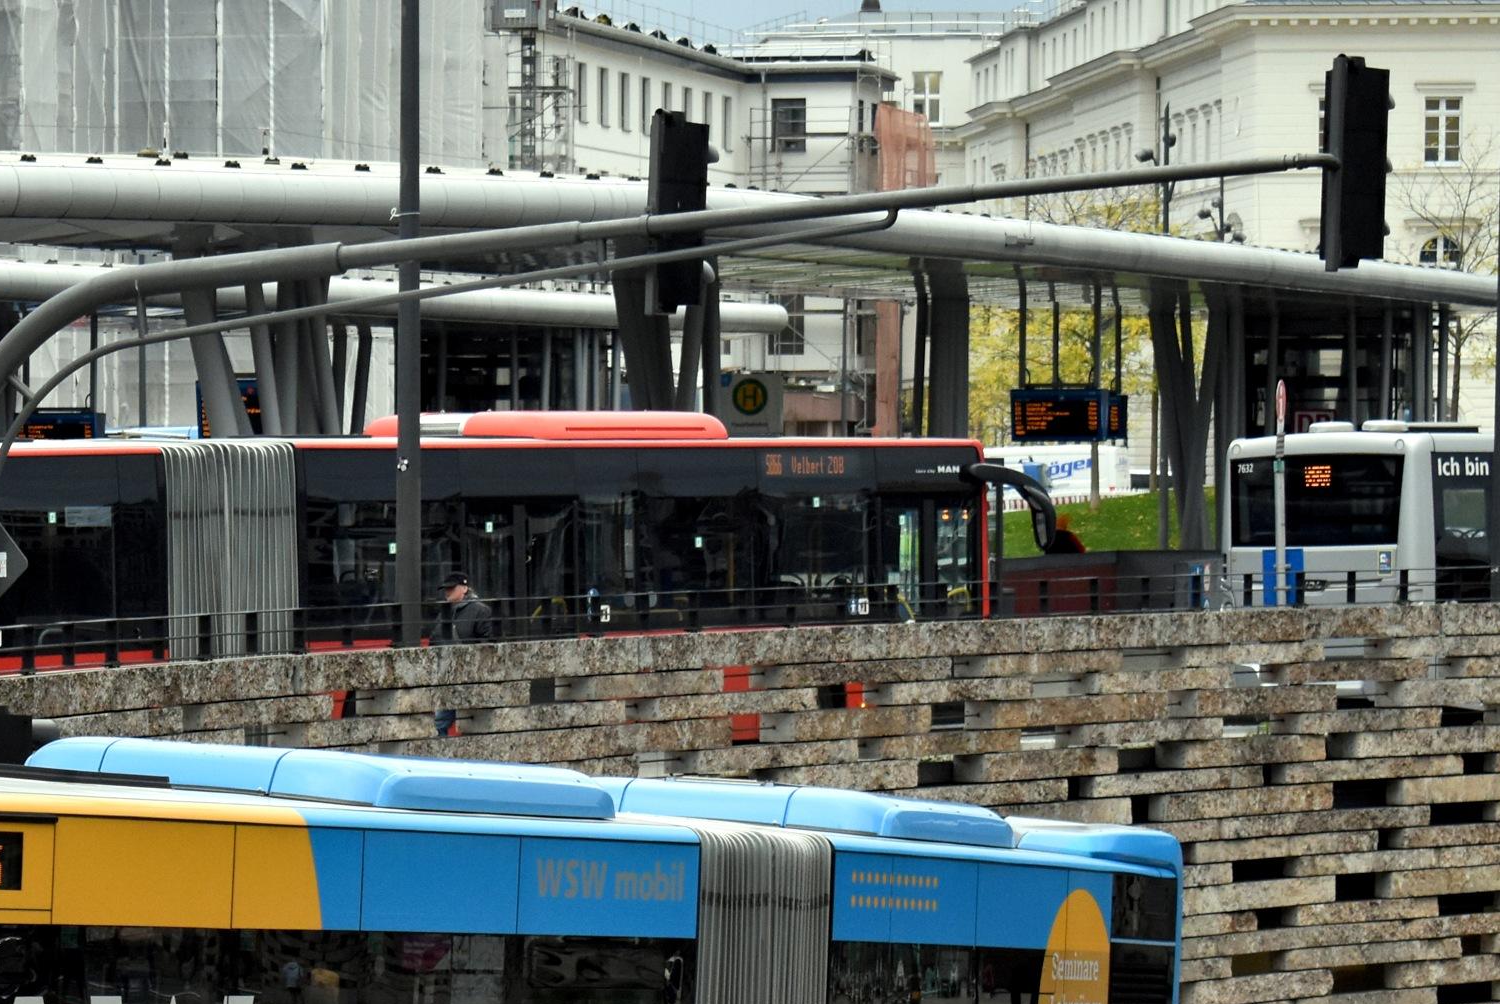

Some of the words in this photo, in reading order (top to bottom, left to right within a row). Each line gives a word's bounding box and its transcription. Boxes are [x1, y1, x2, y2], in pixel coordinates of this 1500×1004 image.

[791, 456, 824, 475] Velbert
[937, 465, 961, 474] MAN
[1237, 463, 1254, 474] 7632
[1438, 458, 1461, 476] Ich
[1465, 456, 1489, 476] bin
[536, 858, 608, 899] WSW
[614, 860, 686, 901] mobil
[1051, 952, 1099, 982] Seminare
